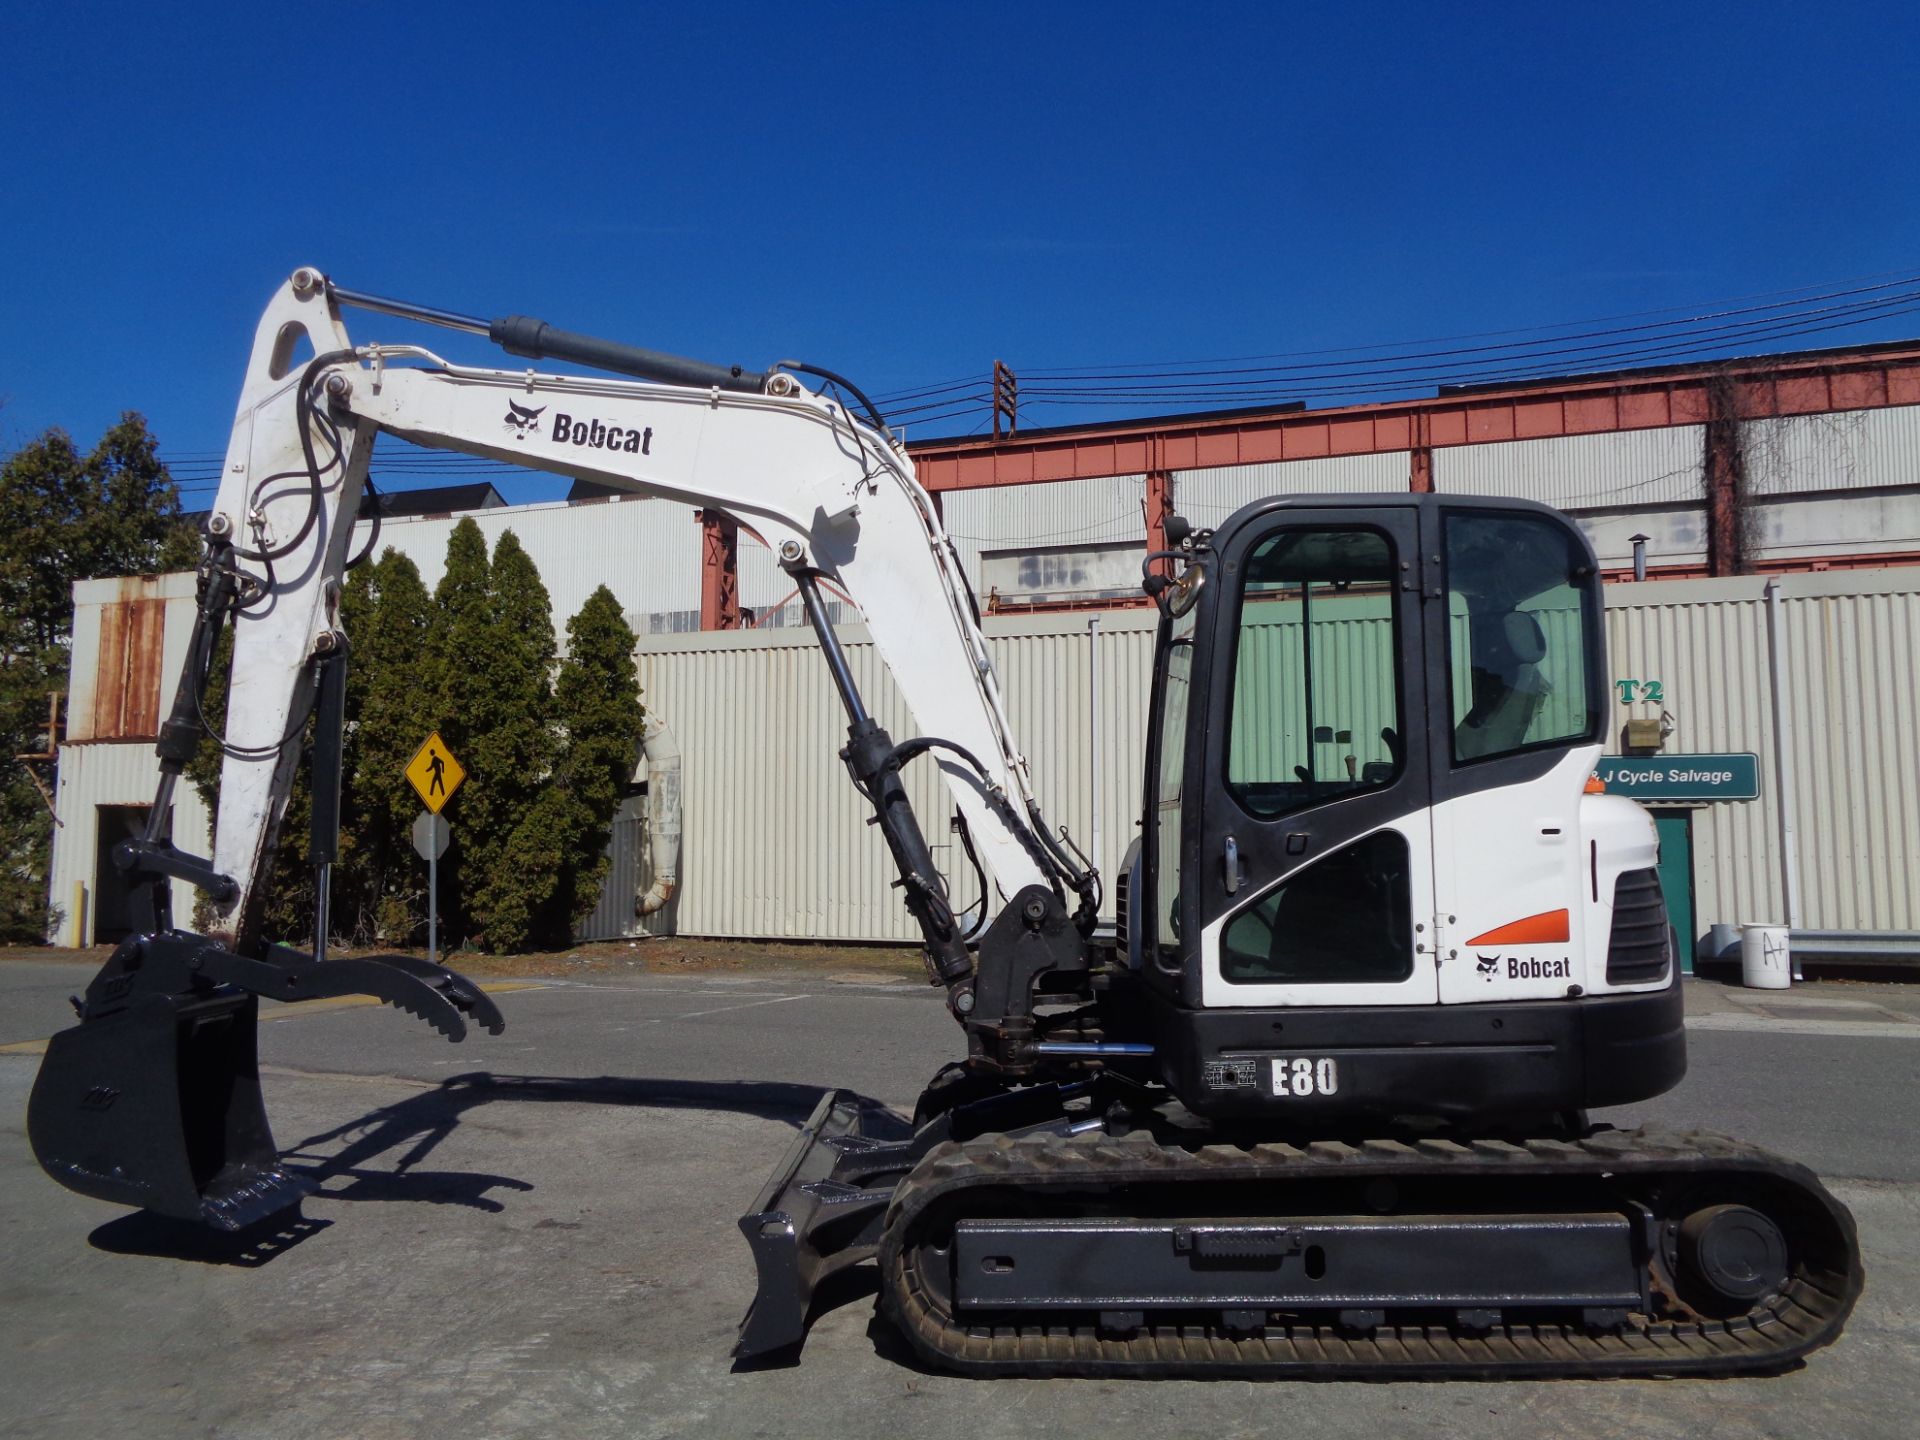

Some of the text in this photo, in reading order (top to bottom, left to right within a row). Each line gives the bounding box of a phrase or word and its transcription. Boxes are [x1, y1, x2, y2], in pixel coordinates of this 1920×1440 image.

[552, 413, 653, 456] Bobcat
[1615, 679, 1664, 702] T2
[1604, 770, 1614, 783] J
[1618, 769, 1663, 785] Cycle
[1668, 769, 1733, 785] Salvage
[1507, 956, 1571, 979] Bobcat
[1271, 1058, 1338, 1096] E80
